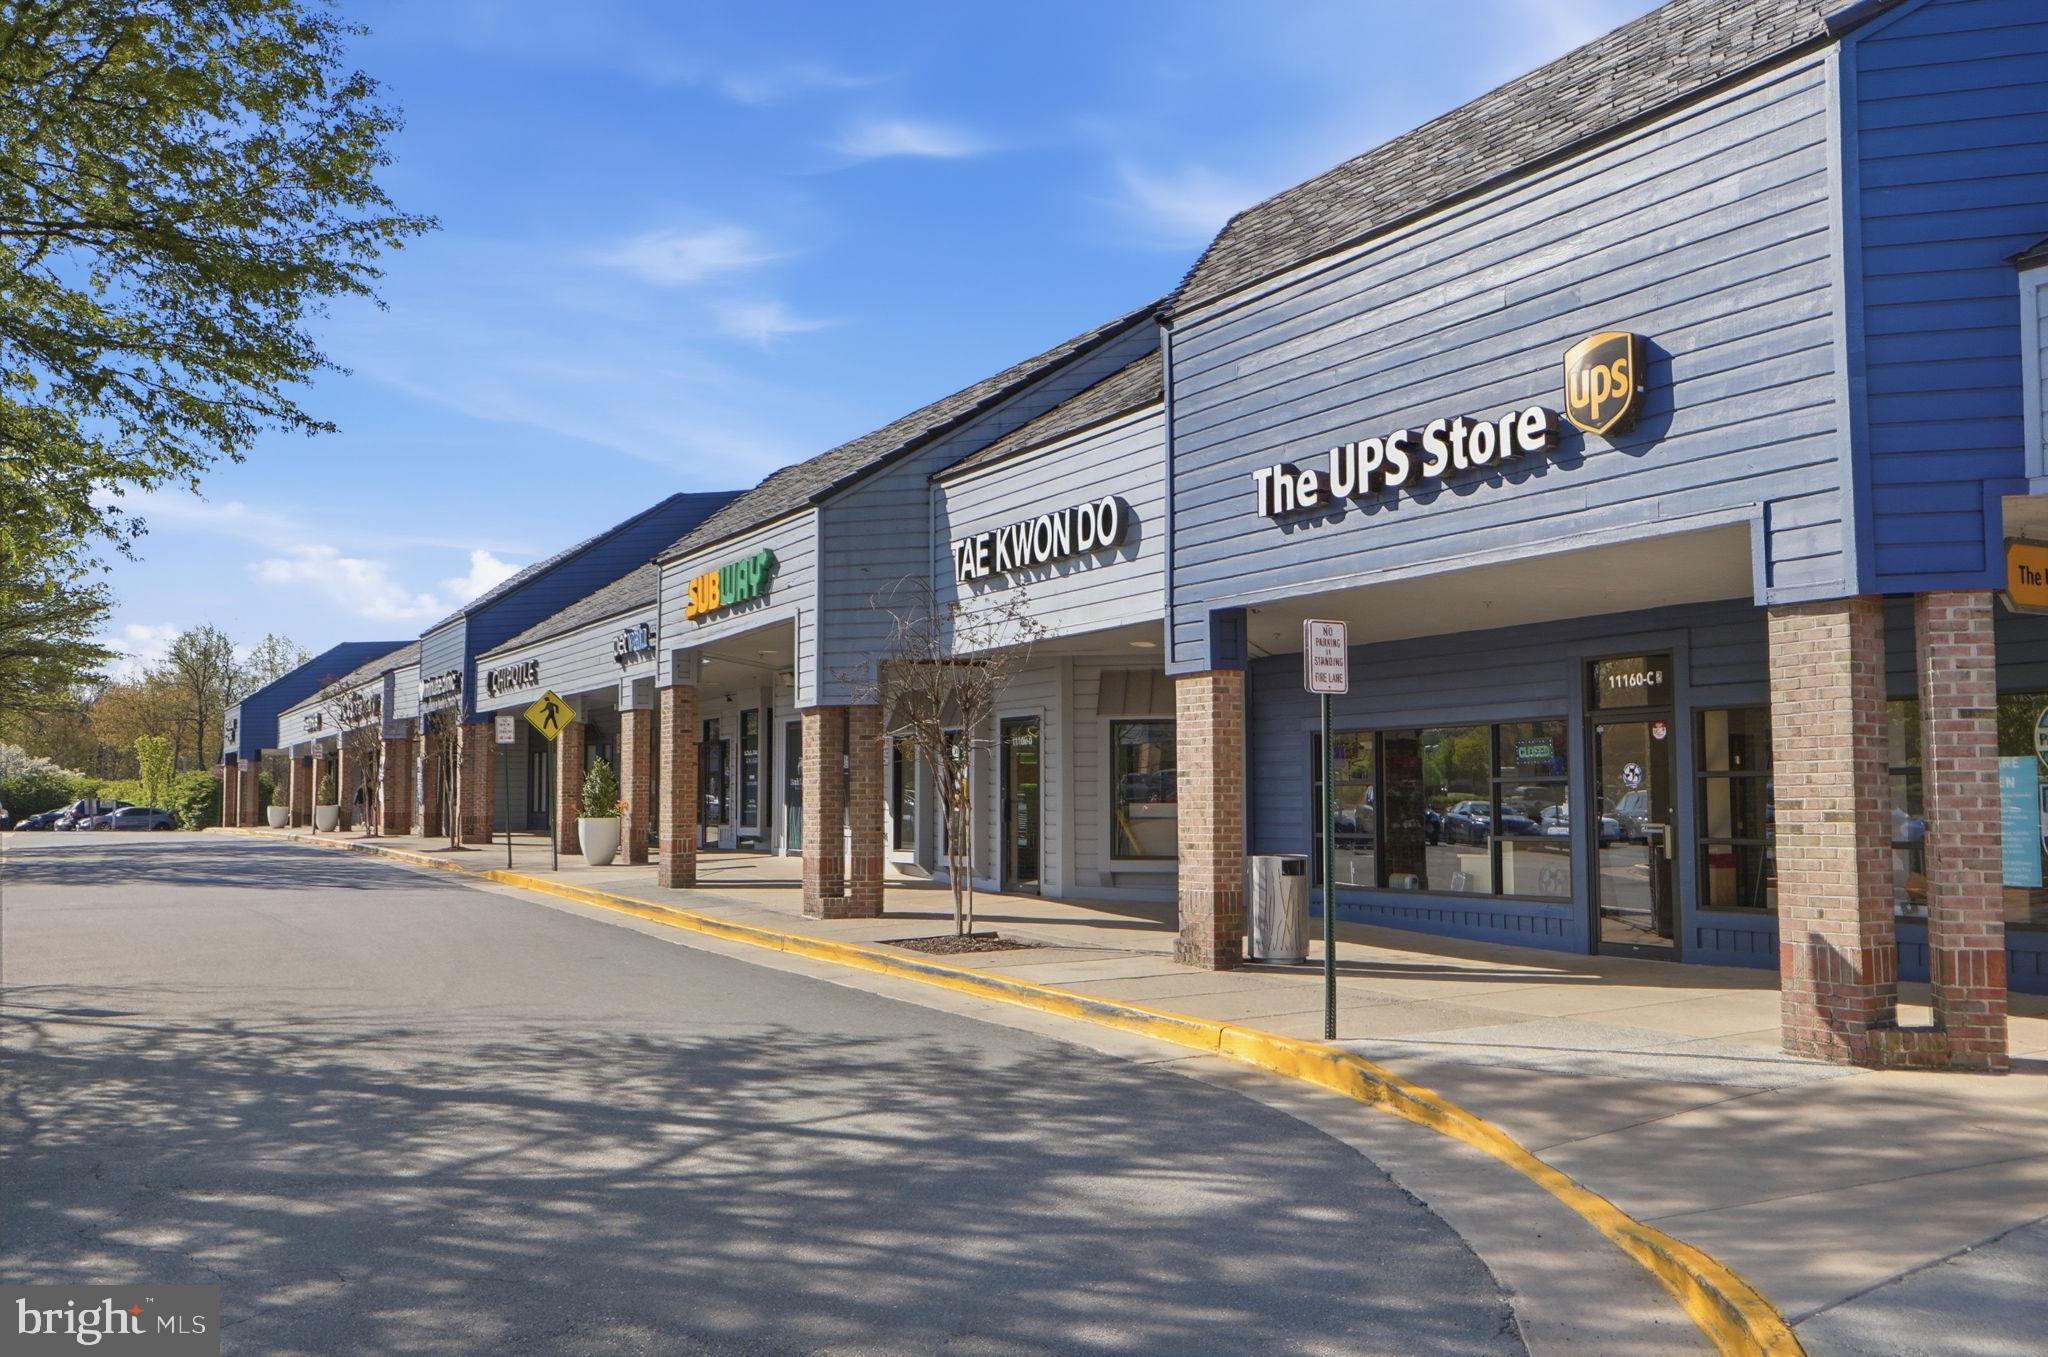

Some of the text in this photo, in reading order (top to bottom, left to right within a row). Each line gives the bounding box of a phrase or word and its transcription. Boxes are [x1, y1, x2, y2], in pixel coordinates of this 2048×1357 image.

[1570, 357, 1629, 420] ups
[1252, 406, 1547, 517] The UPS Store
[951, 495, 1118, 581] TAE KWON DO
[685, 549, 768, 618] SUBWAY
[2018, 564, 2042, 586] The
[1315, 637, 1341, 648] PARKING
[1322, 627, 1333, 636] NO
[492, 659, 536, 690] CHIPOTLE
[1314, 656, 1343, 667] STANDING
[1315, 672, 1343, 683] FIRE LANE
